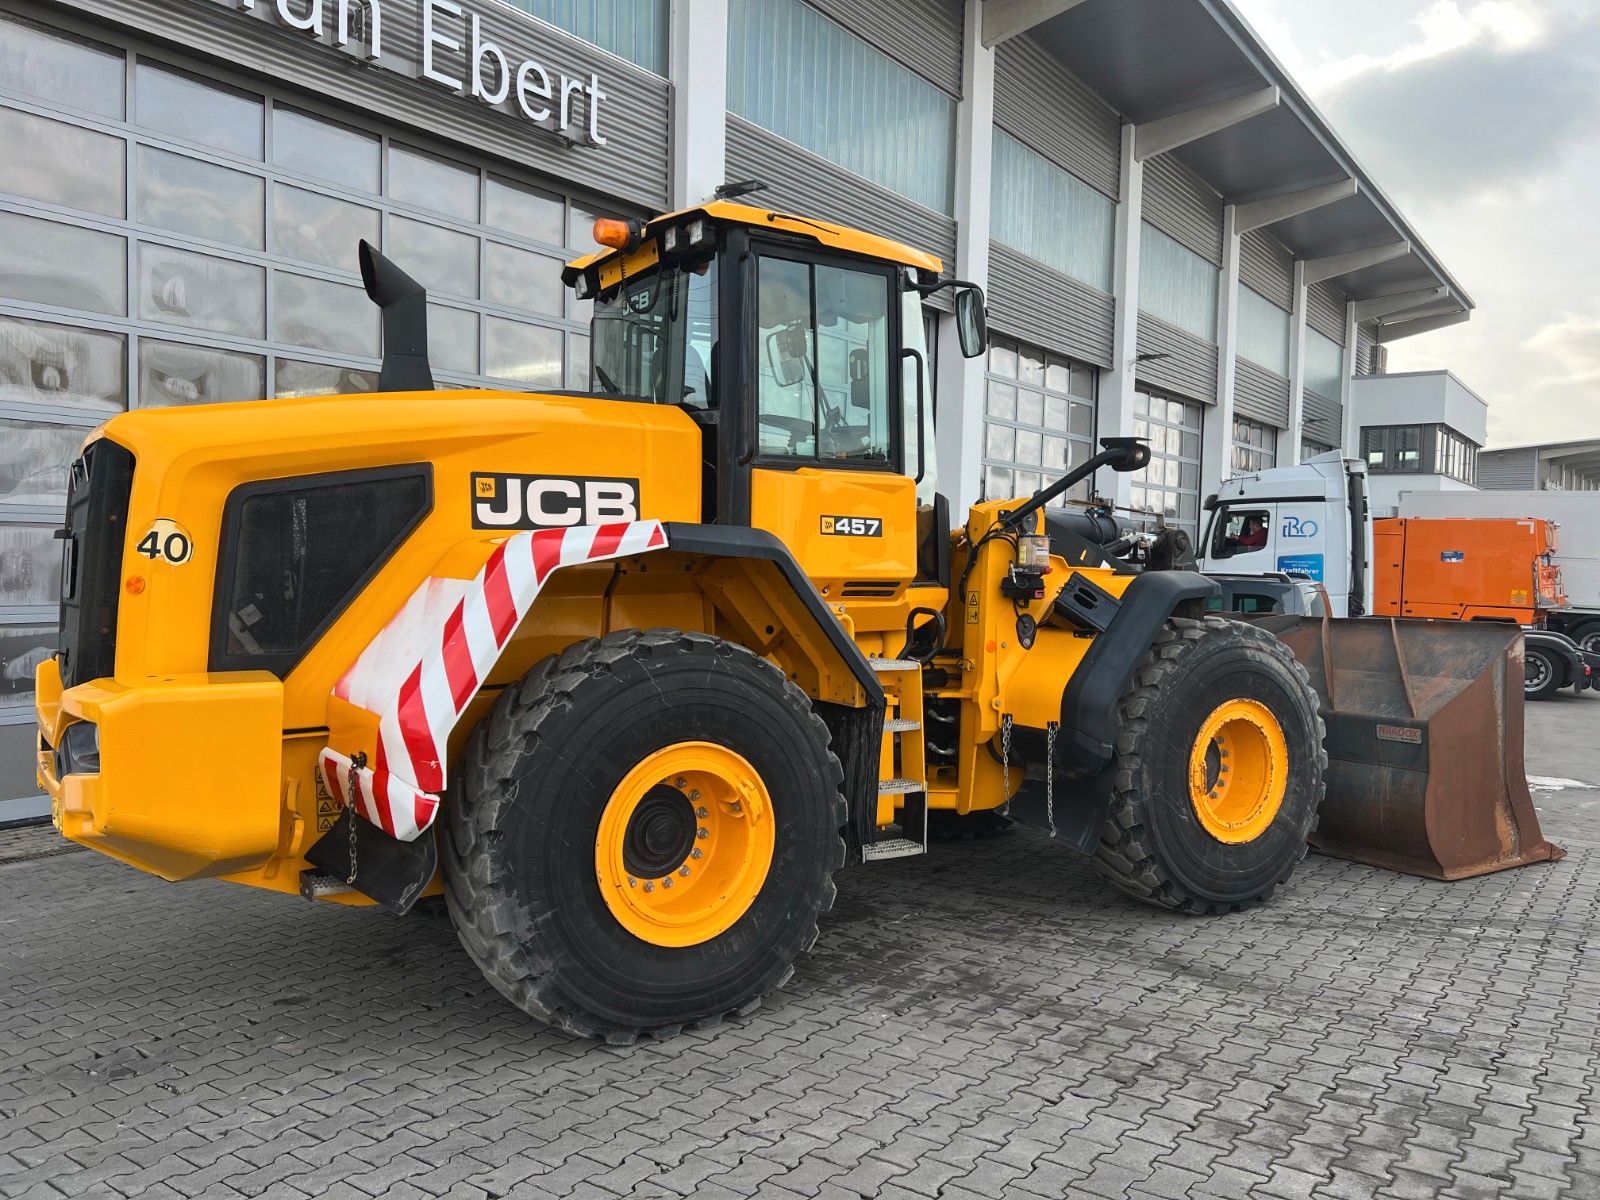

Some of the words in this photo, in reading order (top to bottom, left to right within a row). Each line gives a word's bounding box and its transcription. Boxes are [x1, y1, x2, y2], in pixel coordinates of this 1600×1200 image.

[422, 0, 607, 146] Ebert
[476, 478, 637, 526] JCB
[835, 518, 880, 535] 457
[137, 531, 189, 562] 40
[1280, 566, 1320, 575] Kraftfahrer
